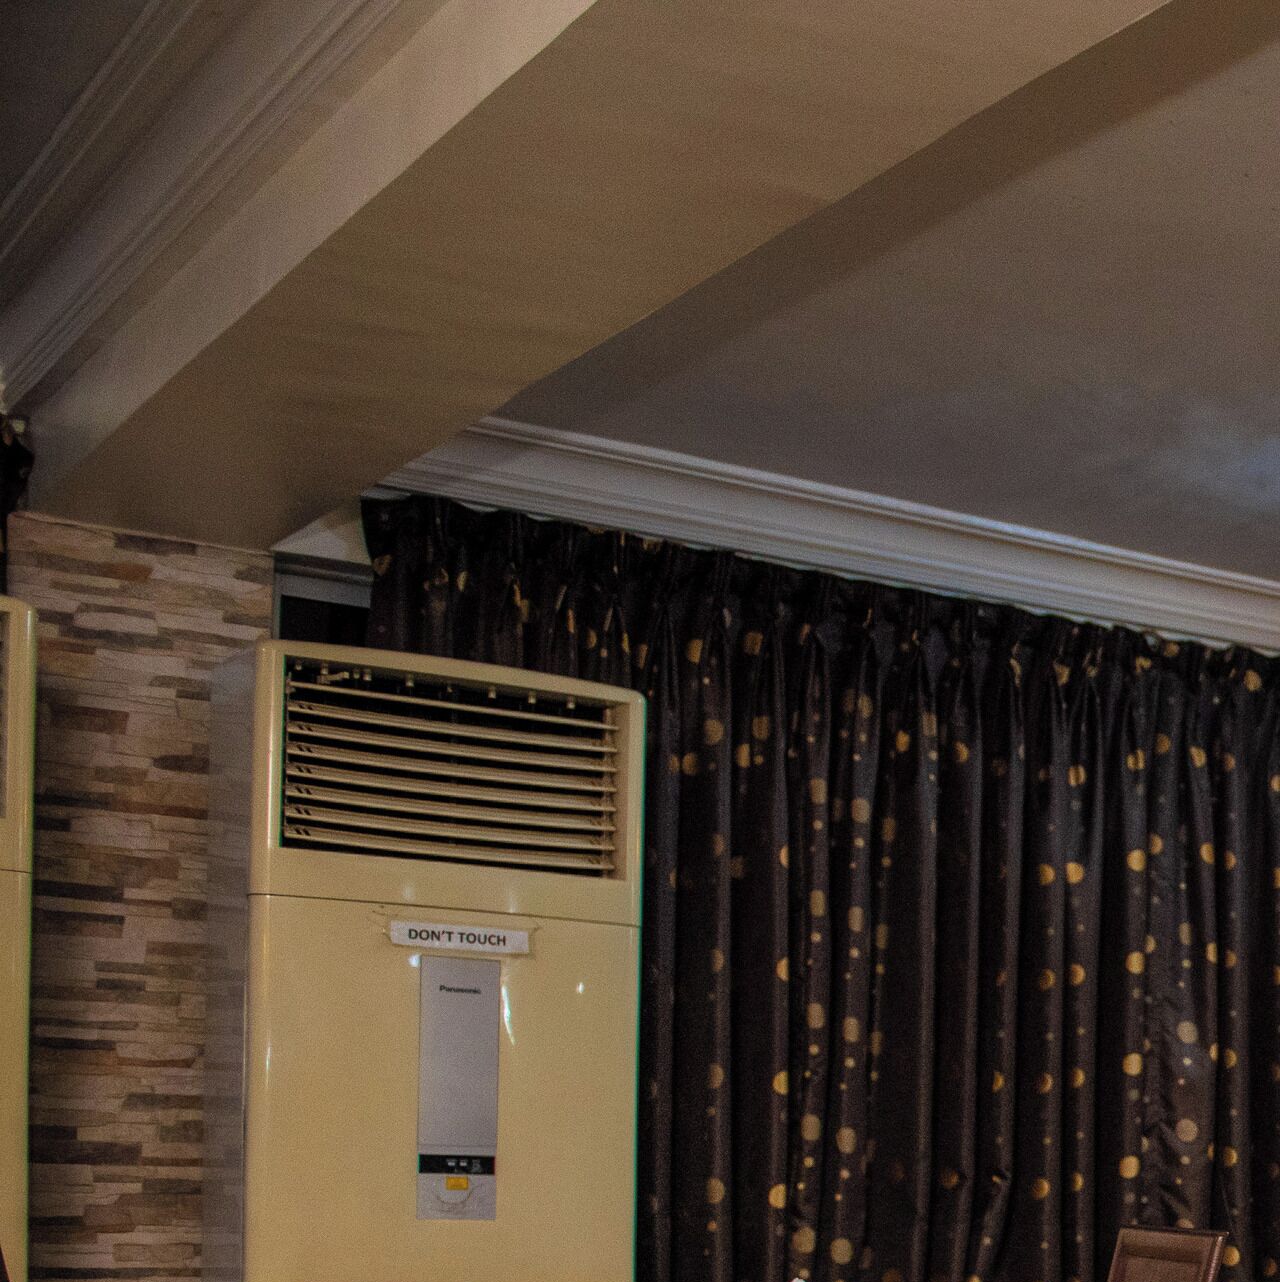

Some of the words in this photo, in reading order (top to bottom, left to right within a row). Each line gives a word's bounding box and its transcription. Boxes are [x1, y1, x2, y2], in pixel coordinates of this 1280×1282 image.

[408, 928, 454, 943] DON'T
[457, 931, 507, 947] TOUCH
[439, 984, 481, 995] Panasonic
